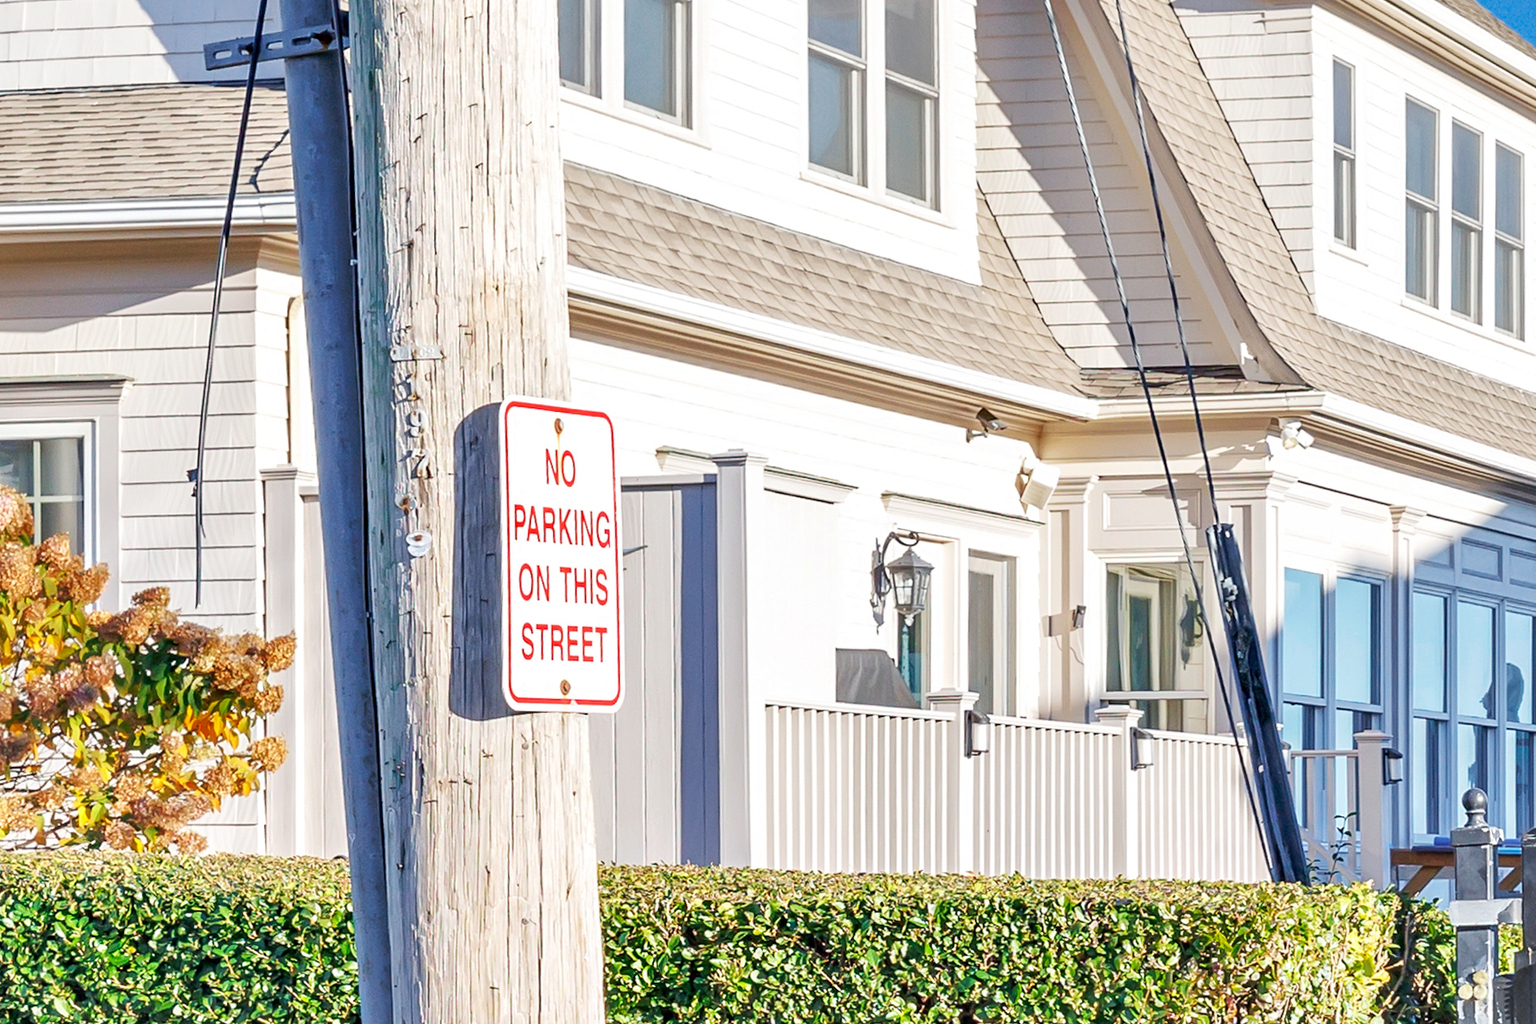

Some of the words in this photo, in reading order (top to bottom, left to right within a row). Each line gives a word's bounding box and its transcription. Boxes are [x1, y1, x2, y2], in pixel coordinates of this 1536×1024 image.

[546, 449, 576, 487] NO
[514, 504, 611, 548] PARKING
[519, 563, 550, 601] ON
[559, 566, 609, 606] THIS
[521, 622, 608, 662] STREET
